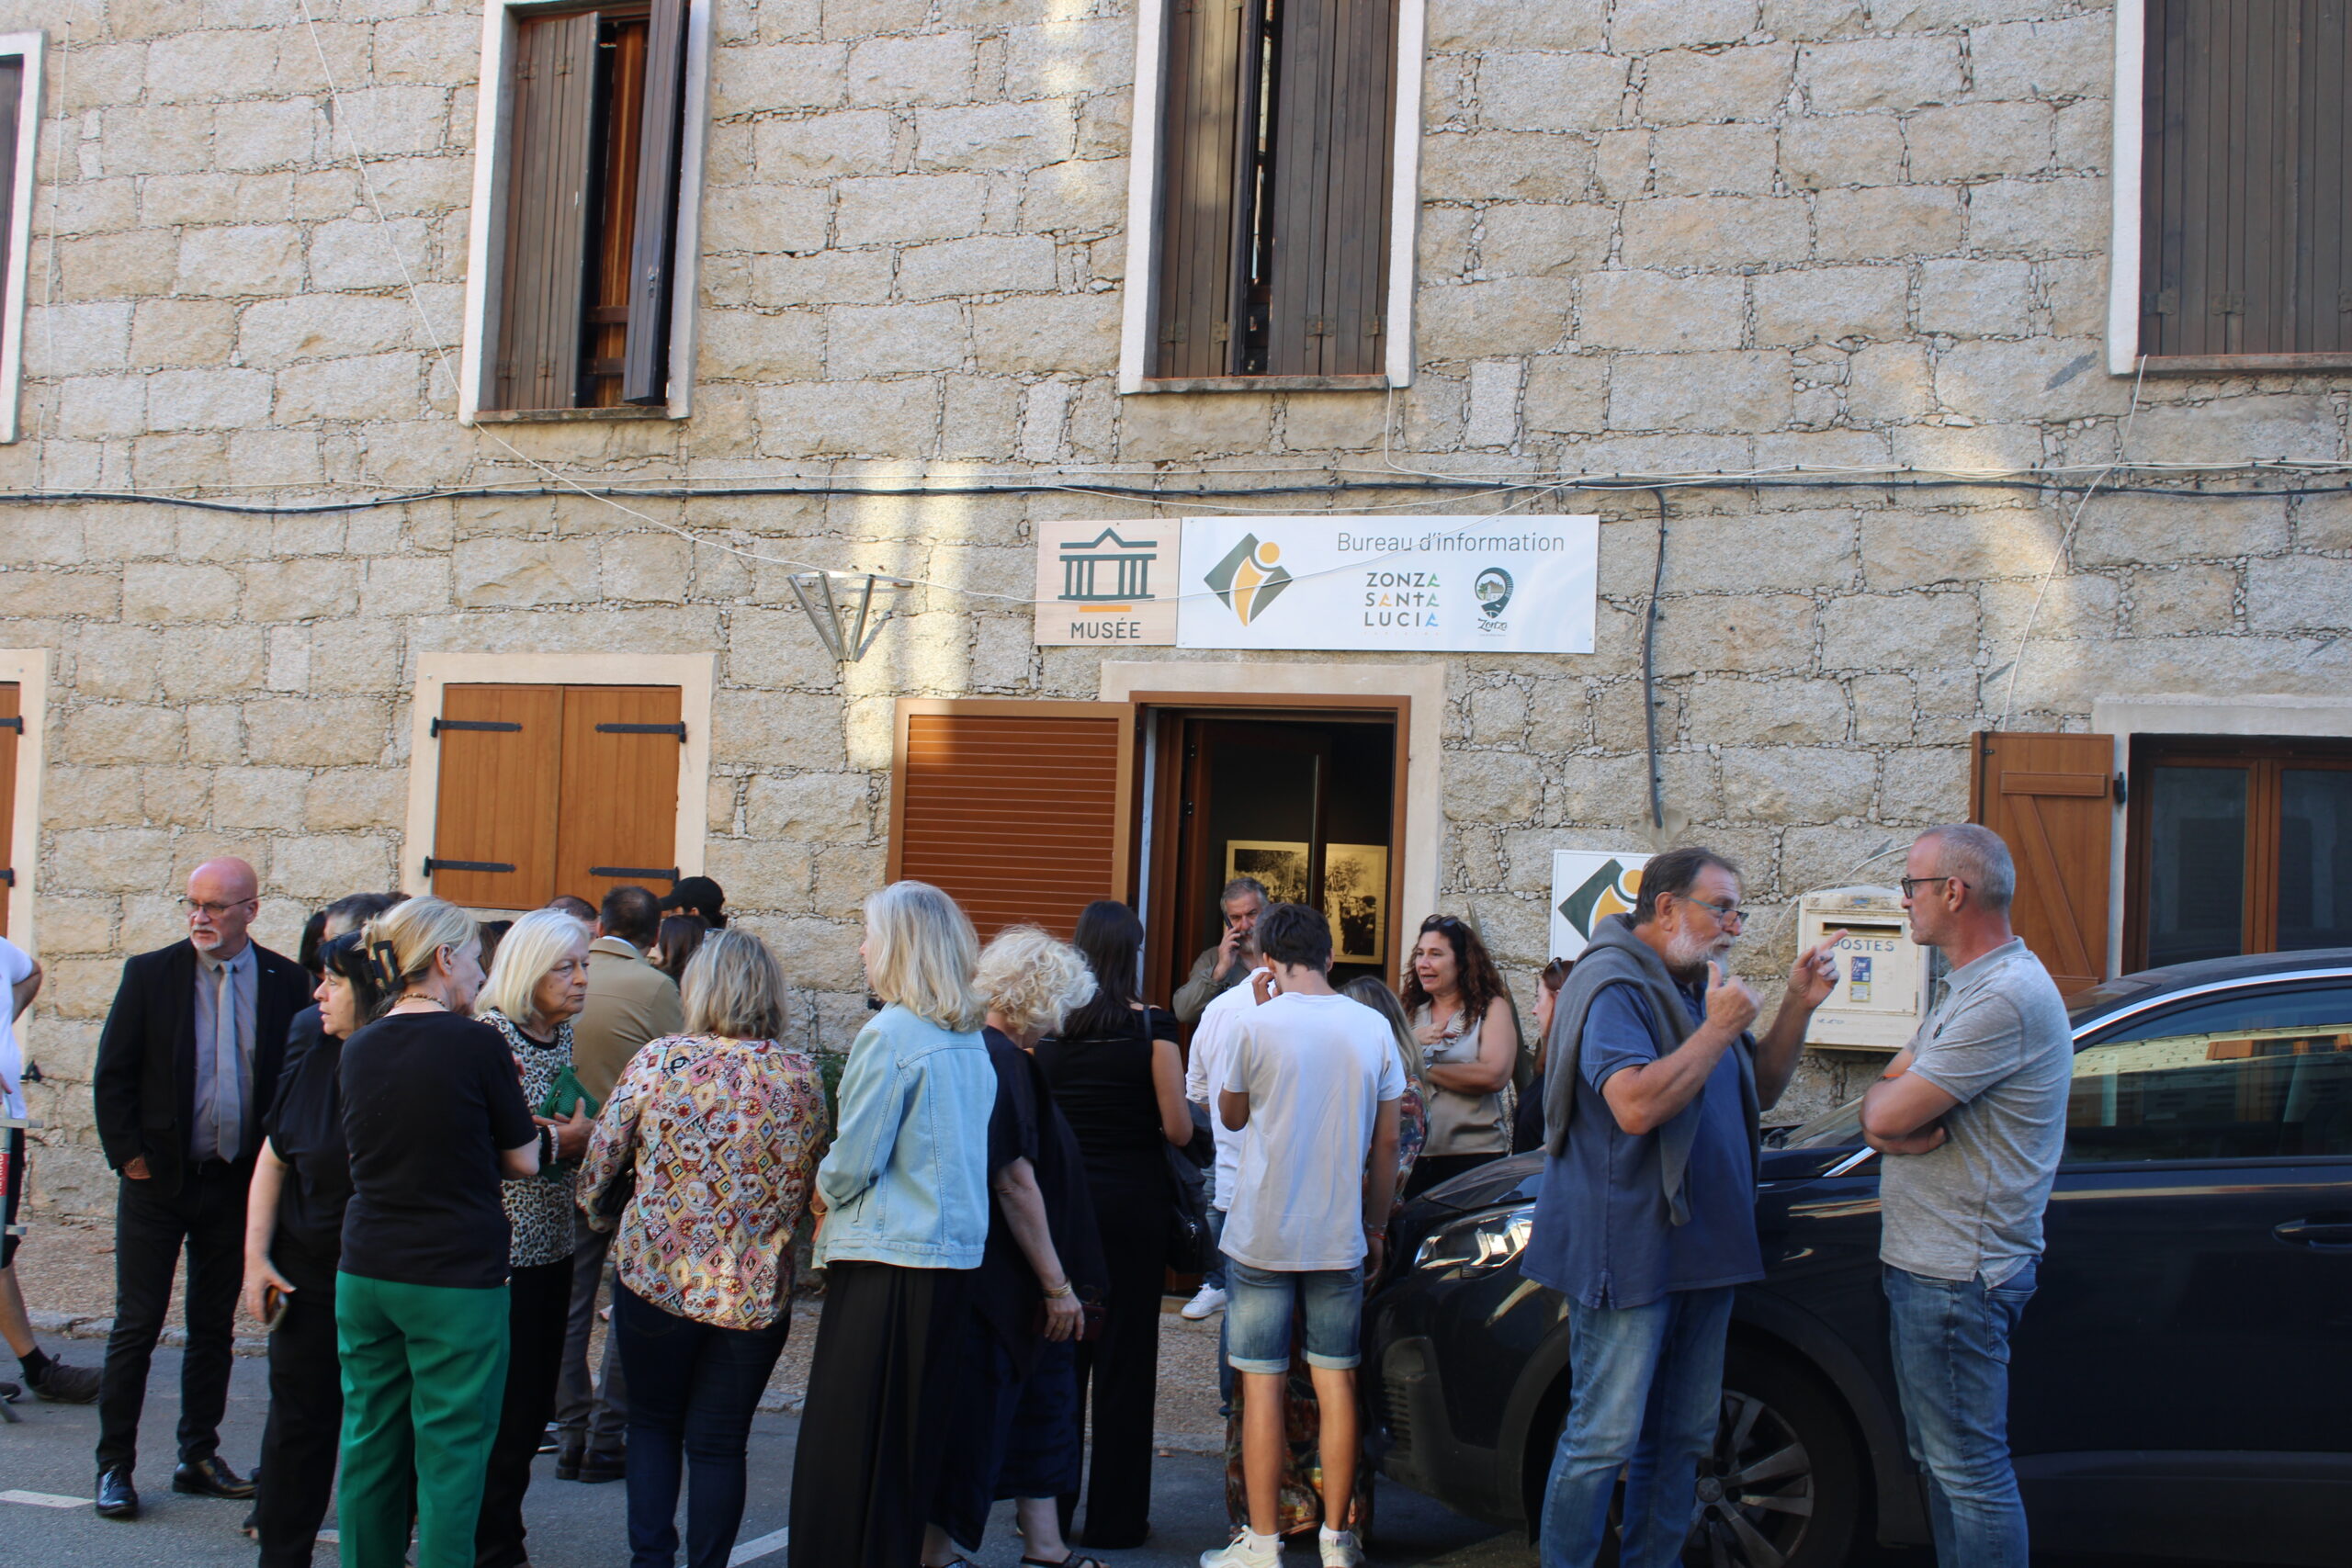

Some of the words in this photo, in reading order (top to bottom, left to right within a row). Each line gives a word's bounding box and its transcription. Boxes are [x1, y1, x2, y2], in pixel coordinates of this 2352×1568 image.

[1338, 532, 1412, 551] Bureau
[1419, 532, 1565, 551] d'information
[1366, 572, 1441, 587] ZONZA
[1364, 611, 1439, 626] LUCIA
[1070, 617, 1141, 638] MUSÉE
